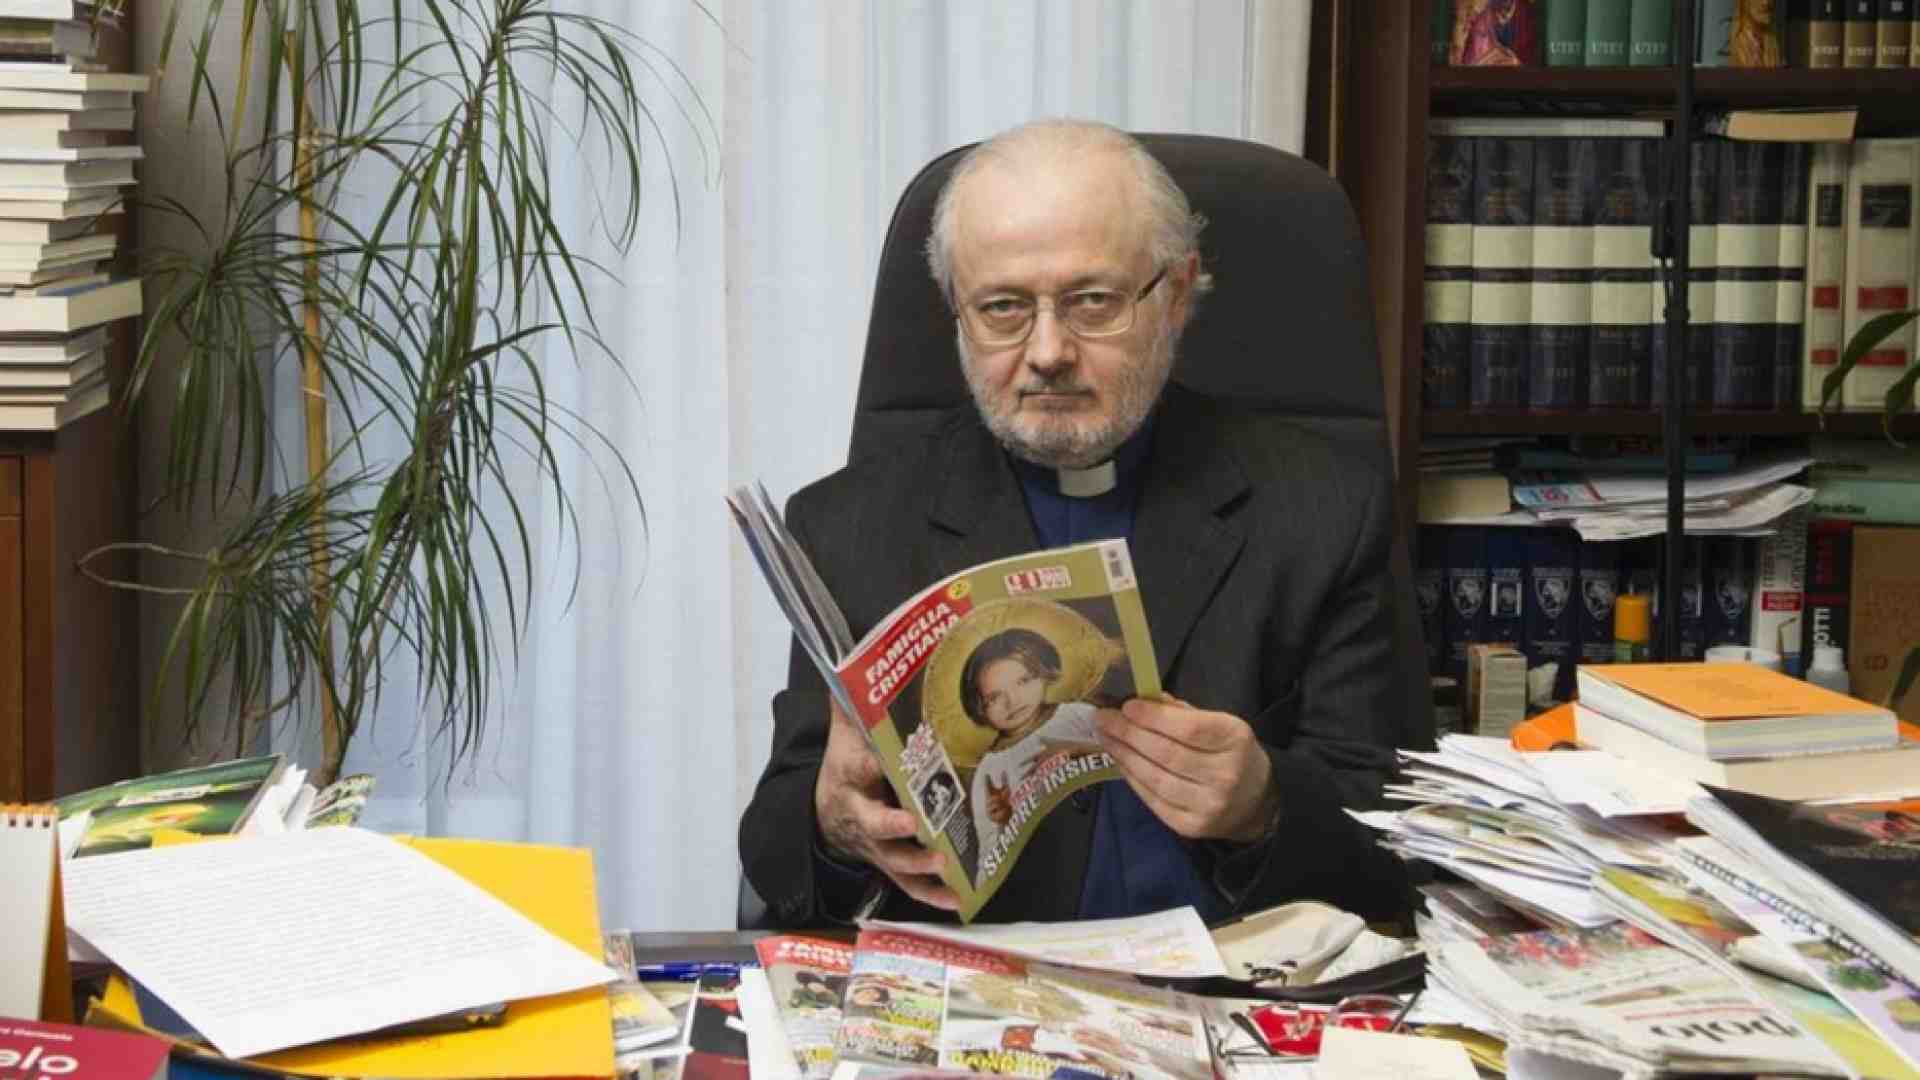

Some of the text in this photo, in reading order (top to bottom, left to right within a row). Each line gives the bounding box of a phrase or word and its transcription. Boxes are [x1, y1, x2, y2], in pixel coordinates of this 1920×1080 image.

[865, 601, 951, 684] FAMIGLIA
[867, 614, 961, 704] CRISTIANA
[984, 793, 1040, 876] SEMPRE
